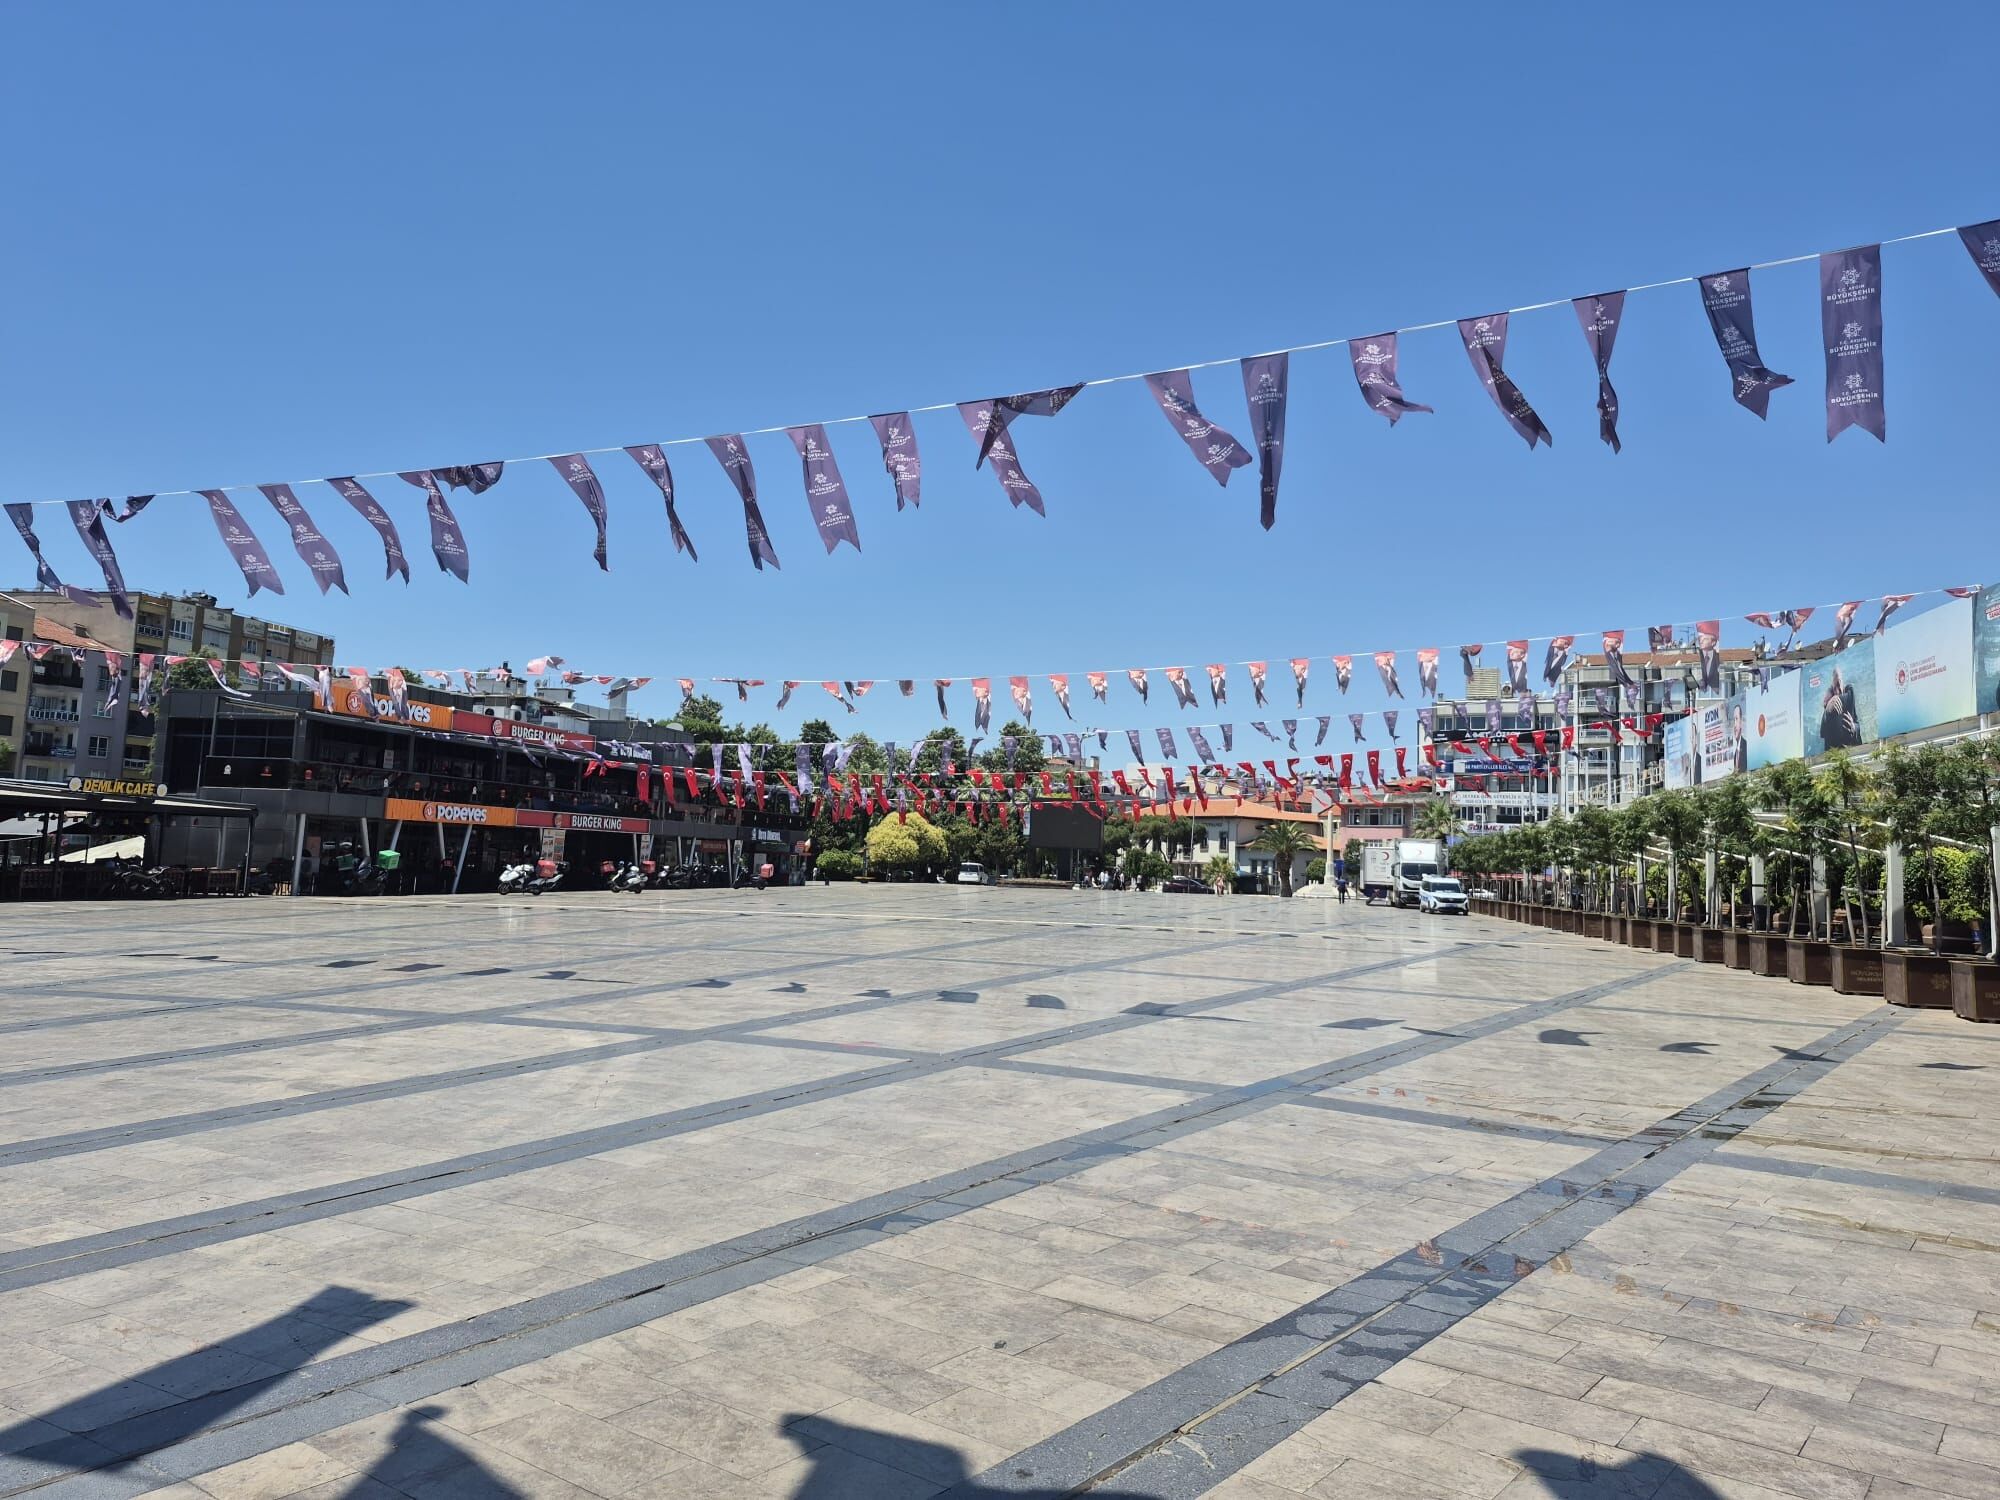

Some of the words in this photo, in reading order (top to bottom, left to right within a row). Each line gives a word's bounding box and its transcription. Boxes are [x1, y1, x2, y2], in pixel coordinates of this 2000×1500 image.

[511, 725, 543, 740] BURGER
[545, 730, 565, 744] KING
[83, 778, 126, 793] DEMLİK
[126, 782, 155, 796] CAFE
[572, 815, 602, 829] BURGER
[604, 818, 622, 830] KING
